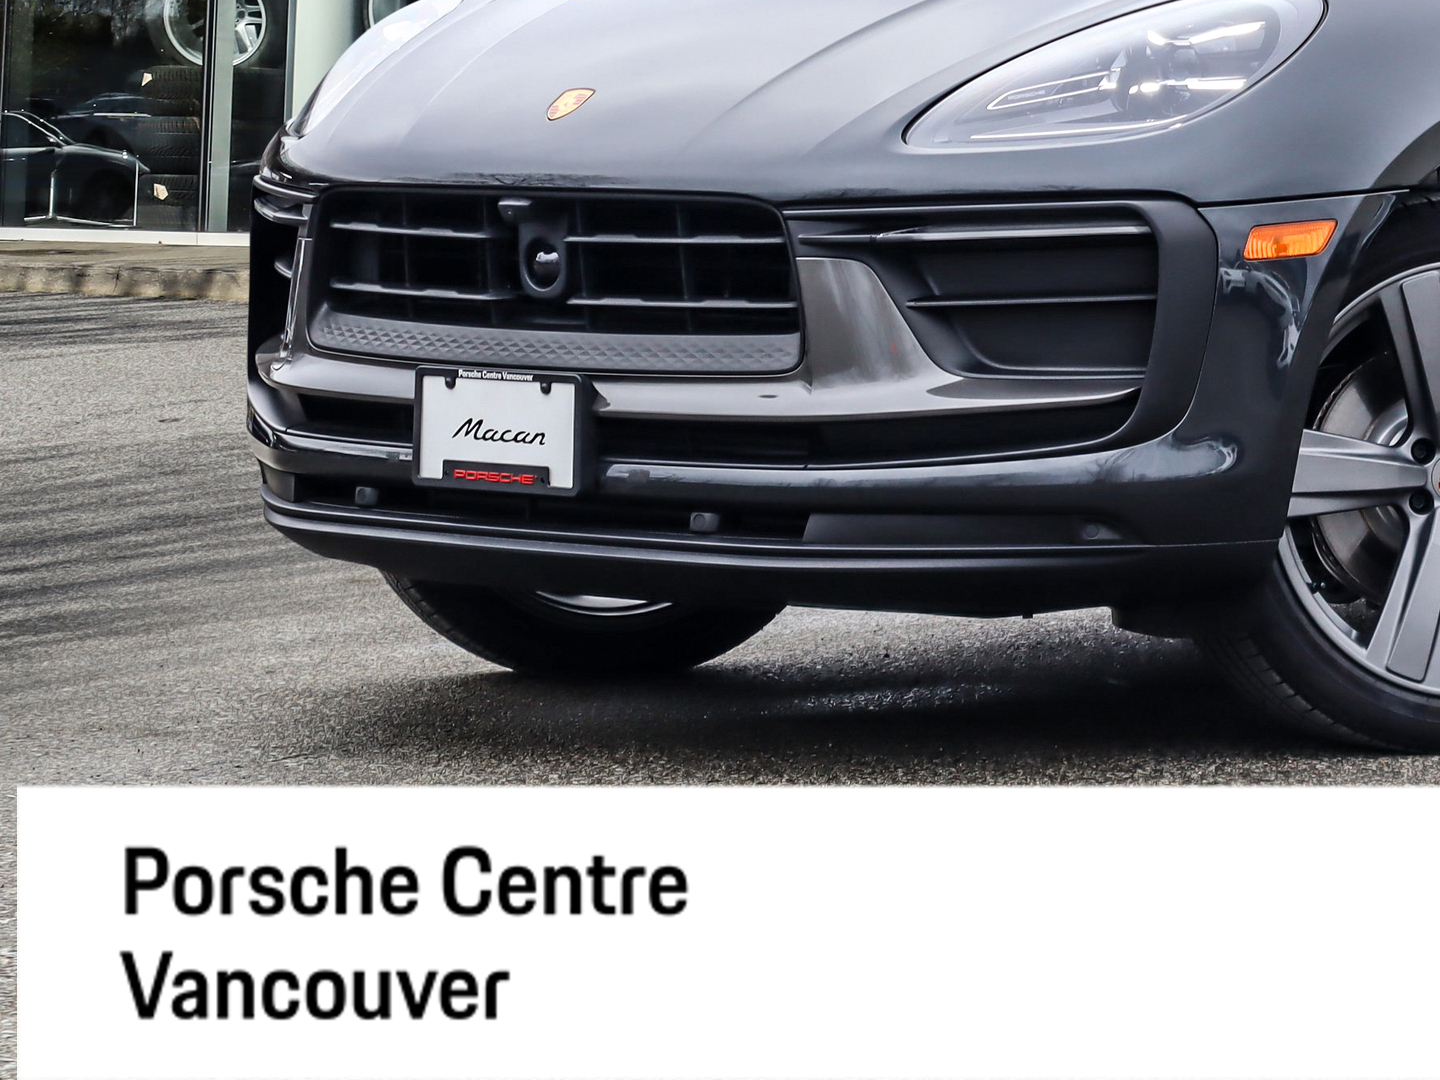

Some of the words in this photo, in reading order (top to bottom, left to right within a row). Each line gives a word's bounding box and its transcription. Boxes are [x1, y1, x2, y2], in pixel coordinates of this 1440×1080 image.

[458, 369, 481, 378] Porsche
[482, 370, 502, 380] Centre
[502, 371, 534, 381] Vancouver
[451, 417, 547, 446] Macan
[454, 469, 536, 484] PORSCHE
